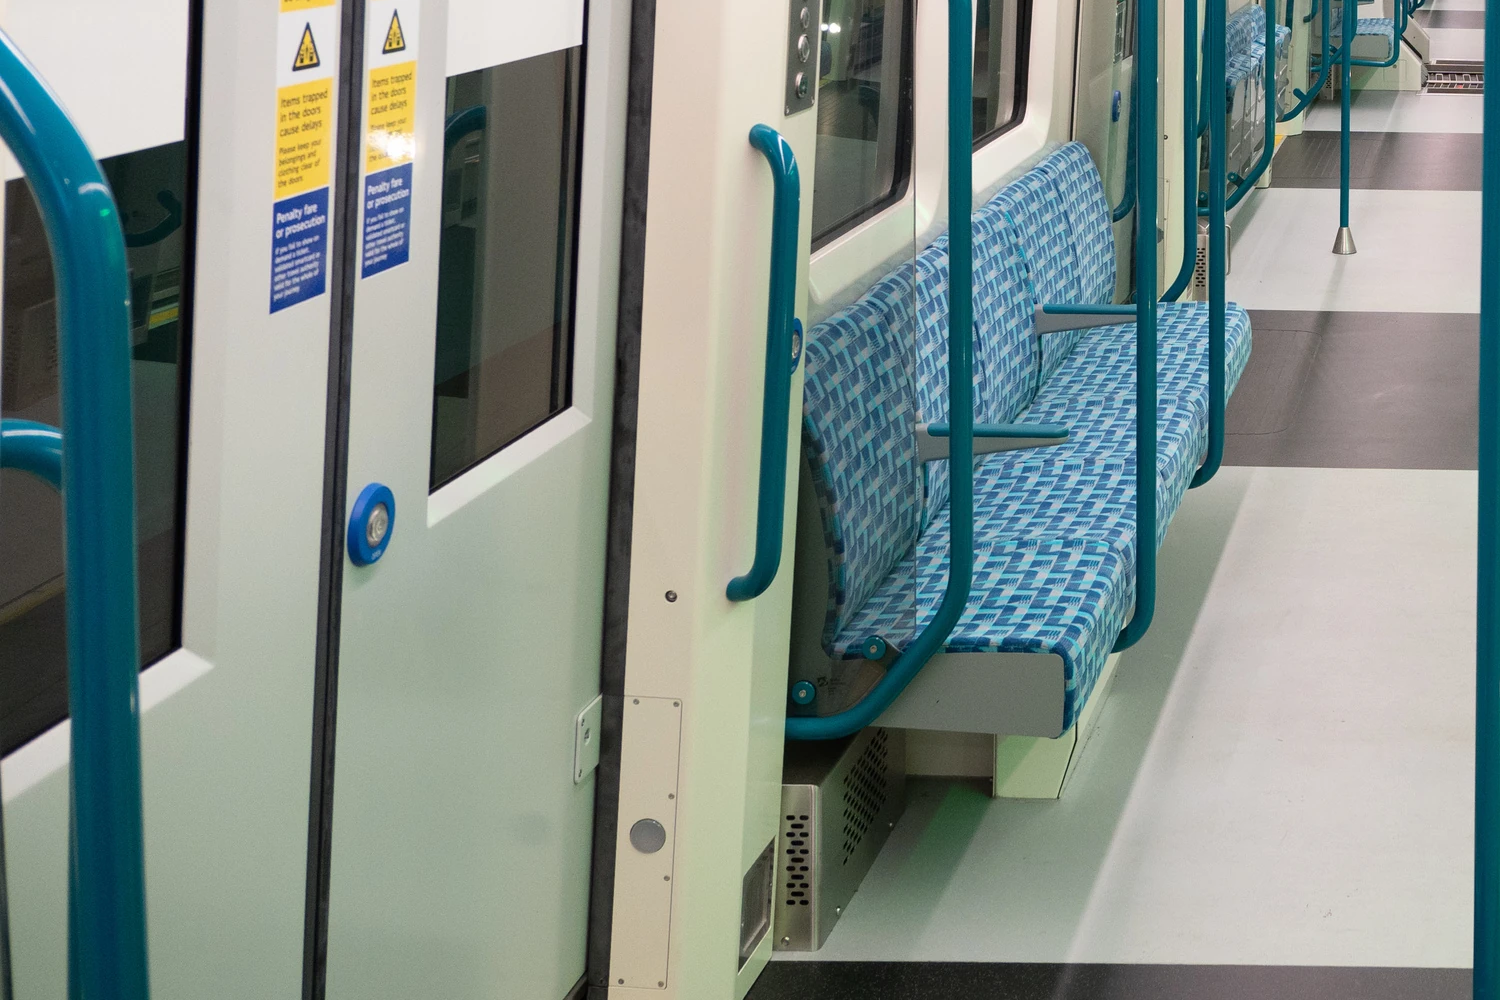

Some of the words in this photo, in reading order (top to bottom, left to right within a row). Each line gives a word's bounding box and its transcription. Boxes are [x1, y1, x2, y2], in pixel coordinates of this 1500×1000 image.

[372, 78, 389, 88] Items
[391, 72, 412, 84] trapped
[281, 97, 300, 108] Items
[303, 88, 328, 104] trapped
[379, 91, 388, 100] the
[390, 88, 406, 97] doors
[280, 114, 287, 122] in
[289, 110, 300, 120] the
[302, 106, 321, 117] doors
[371, 105, 388, 115] cause
[389, 100, 407, 110] delays
[280, 125, 299, 137] cause
[301, 120, 322, 131] delays
[367, 181, 390, 196] Penalty
[391, 178, 403, 189] fare
[367, 200, 374, 209] or
[375, 189, 410, 209] prosecution
[276, 208, 303, 225] Penalty
[304, 203, 318, 215] fare
[275, 228, 284, 239] or
[285, 215, 326, 238] prosecution
